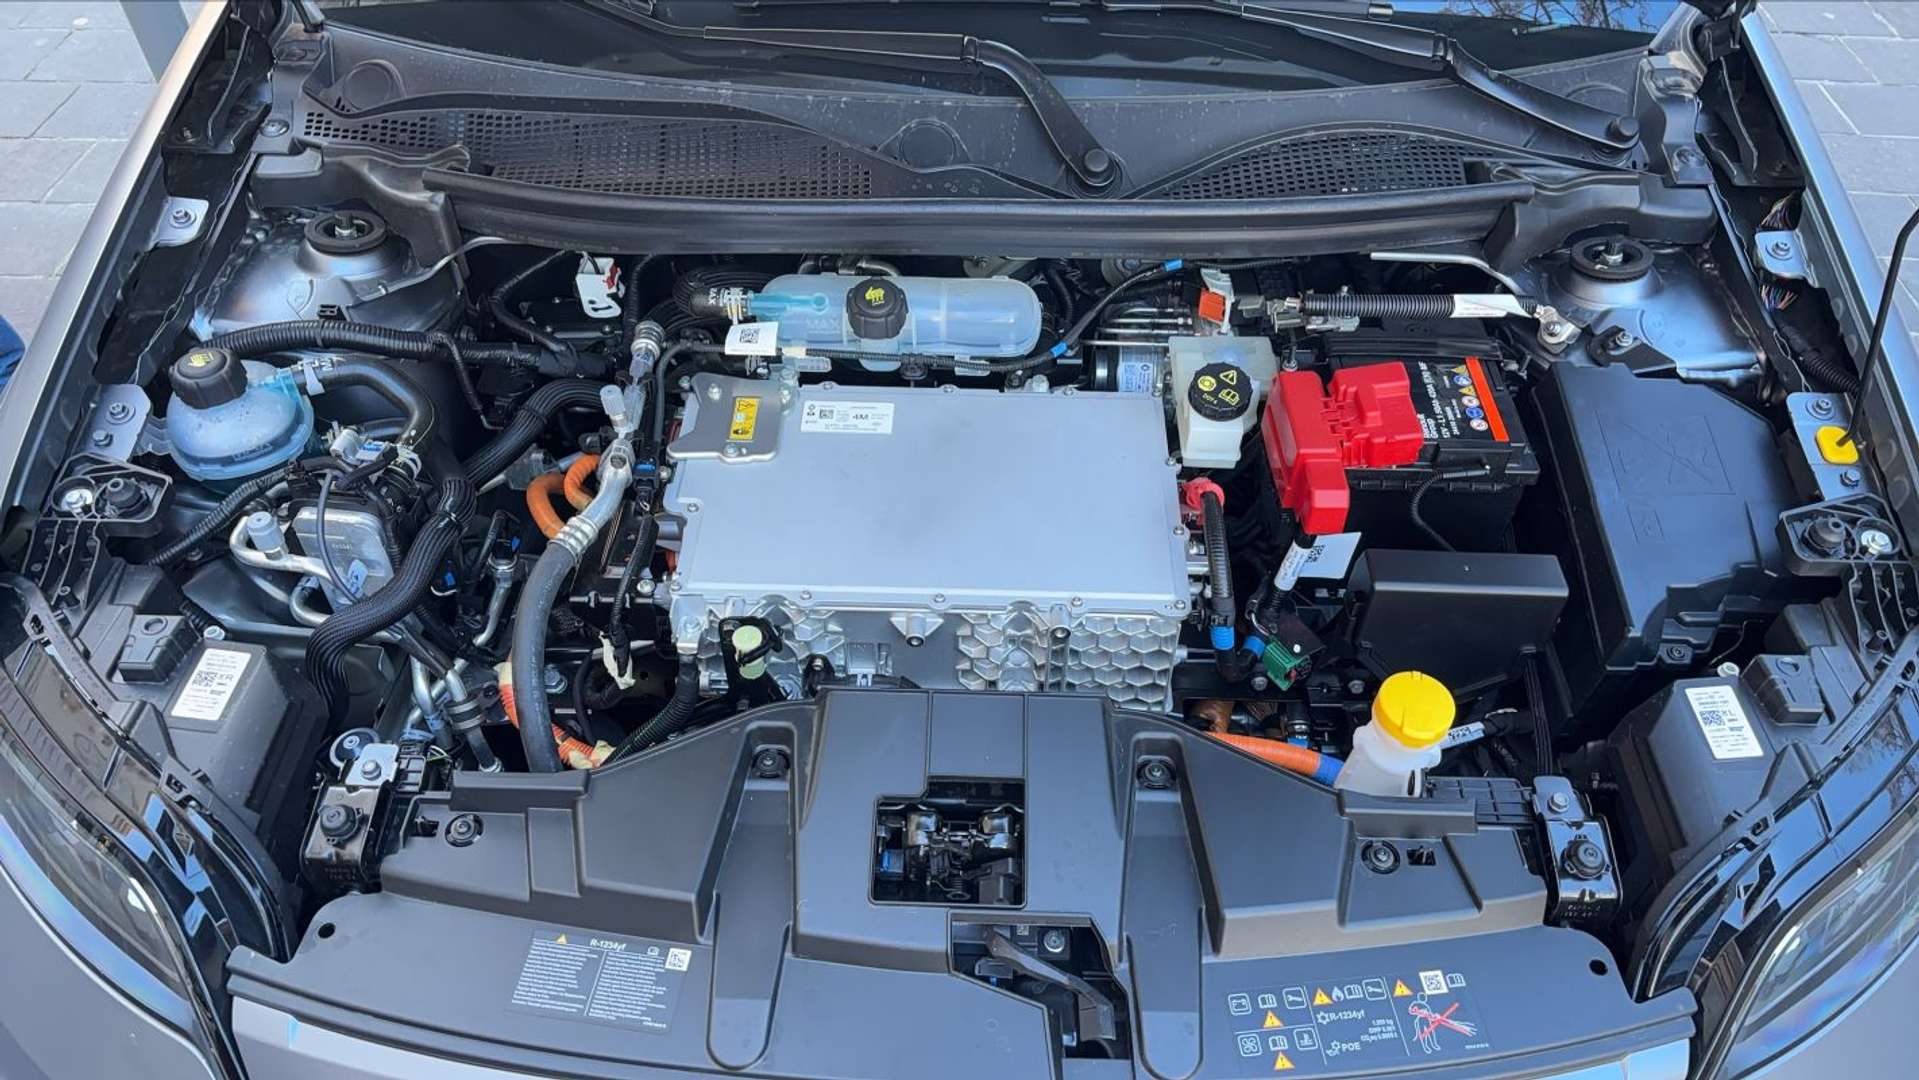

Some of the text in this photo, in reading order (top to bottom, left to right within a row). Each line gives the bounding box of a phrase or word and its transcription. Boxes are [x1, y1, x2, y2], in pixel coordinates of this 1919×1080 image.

[590, 938, 627, 952] R-1234yf
[1330, 1010, 1365, 1020] R-1234yf
[1341, 1042, 1361, 1051] POE
